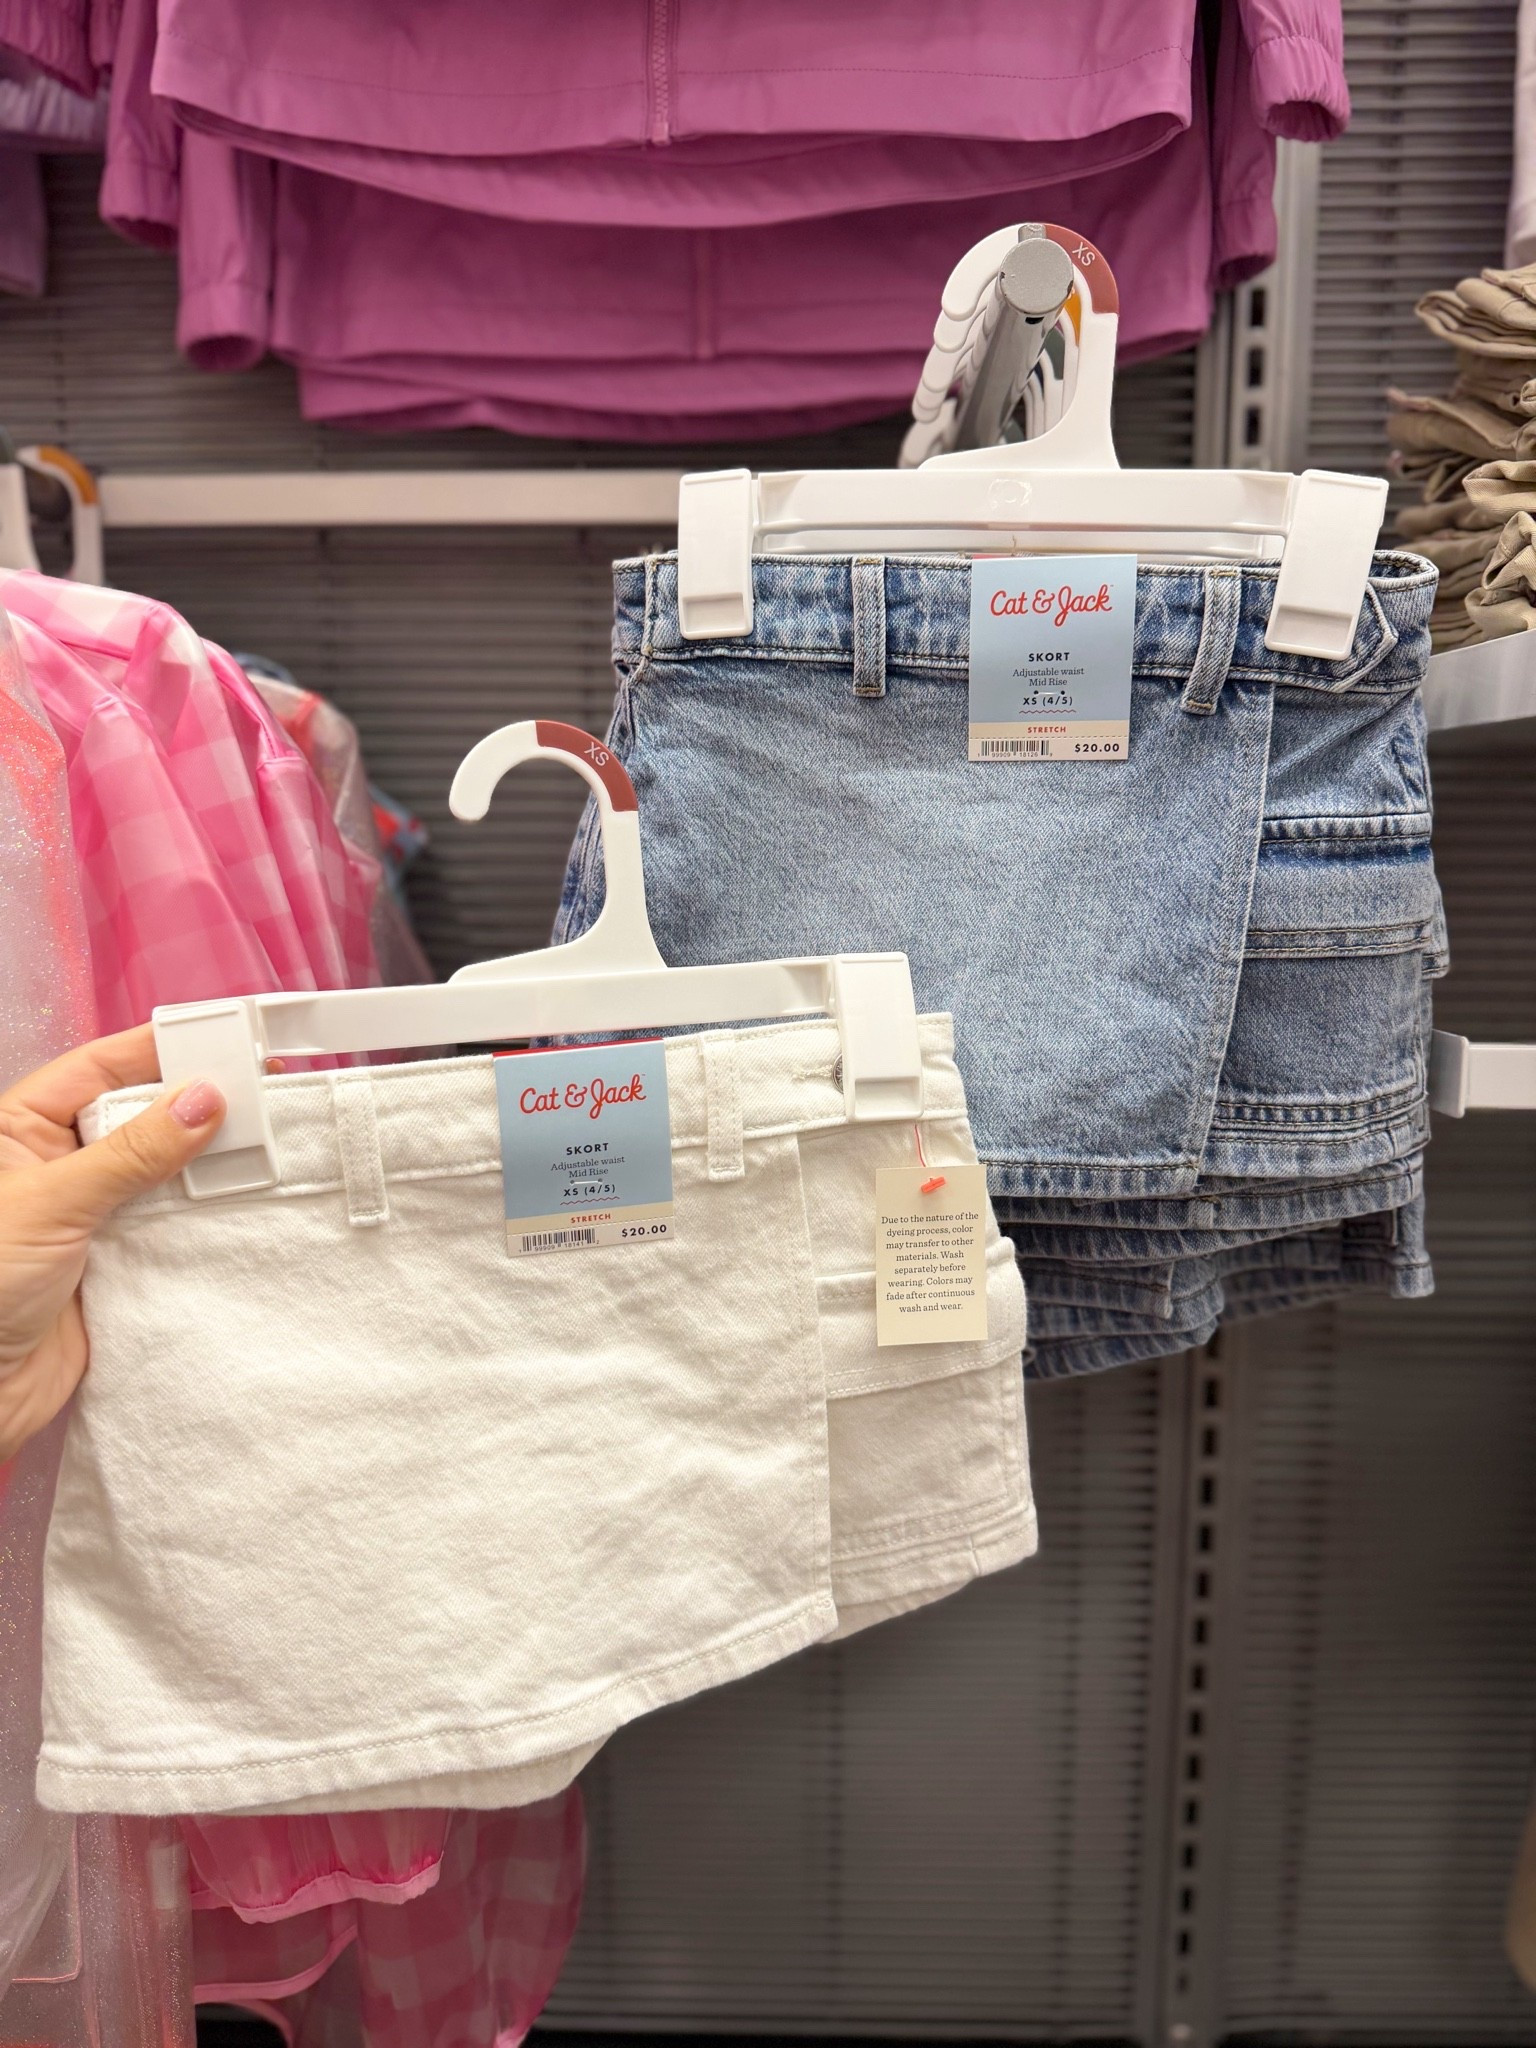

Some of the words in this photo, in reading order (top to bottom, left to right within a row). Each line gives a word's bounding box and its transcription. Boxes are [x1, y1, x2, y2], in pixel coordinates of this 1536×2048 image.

[1072, 241, 1096, 266] XS
[990, 590, 1029, 616] Cat
[1032, 588, 1055, 614] &
[1054, 583, 1113, 627] Jack
[1028, 652, 1070, 662] SKORT
[1012, 668, 1059, 678] Adjustable
[1060, 667, 1084, 676] waist
[1028, 677, 1047, 687] Mid
[1048, 677, 1068, 686] Rise
[1022, 697, 1037, 706] XS
[1042, 696, 1073, 706] (4/5)
[1027, 726, 1067, 734] STRETCH
[584, 741, 610, 766] XS
[1074, 743, 1120, 753] $20.00
[520, 1087, 561, 1114] Cat
[564, 1083, 587, 1108] &
[589, 1073, 647, 1120] Jack
[566, 1143, 609, 1155] SKORT
[551, 1158, 599, 1171] Adjustable
[600, 1156, 625, 1165] waist
[568, 1169, 587, 1178] Mid
[589, 1167, 609, 1176] Rise
[563, 1188, 579, 1197] XS
[584, 1184, 616, 1196] (4/5)
[570, 1213, 611, 1223] STRETCH
[881, 1216, 899, 1224] Due
[910, 1214, 923, 1222] the
[925, 1213, 954, 1222] nature
[955, 1212, 964, 1220] of
[965, 1211, 979, 1220] the
[621, 1224, 667, 1238] $20.00
[886, 1228, 915, 1237] dyeing
[916, 1227, 951, 1236] process,
[952, 1225, 974, 1233] color
[886, 1241, 904, 1250] may
[905, 1239, 940, 1248] transfer
[951, 1237, 974, 1246] other
[896, 1251, 939, 1261] materials.
[940, 1250, 964, 1259] Wash
[894, 1264, 938, 1275] separately
[939, 1263, 966, 1272] before
[887, 1278, 925, 1287] wearing.
[926, 1276, 954, 1286] Colors
[955, 1276, 973, 1285] may
[886, 1292, 904, 1301] fade
[905, 1291, 927, 1300] after
[928, 1289, 975, 1298] continuous
[899, 1304, 921, 1313] wash
[923, 1303, 939, 1312] and
